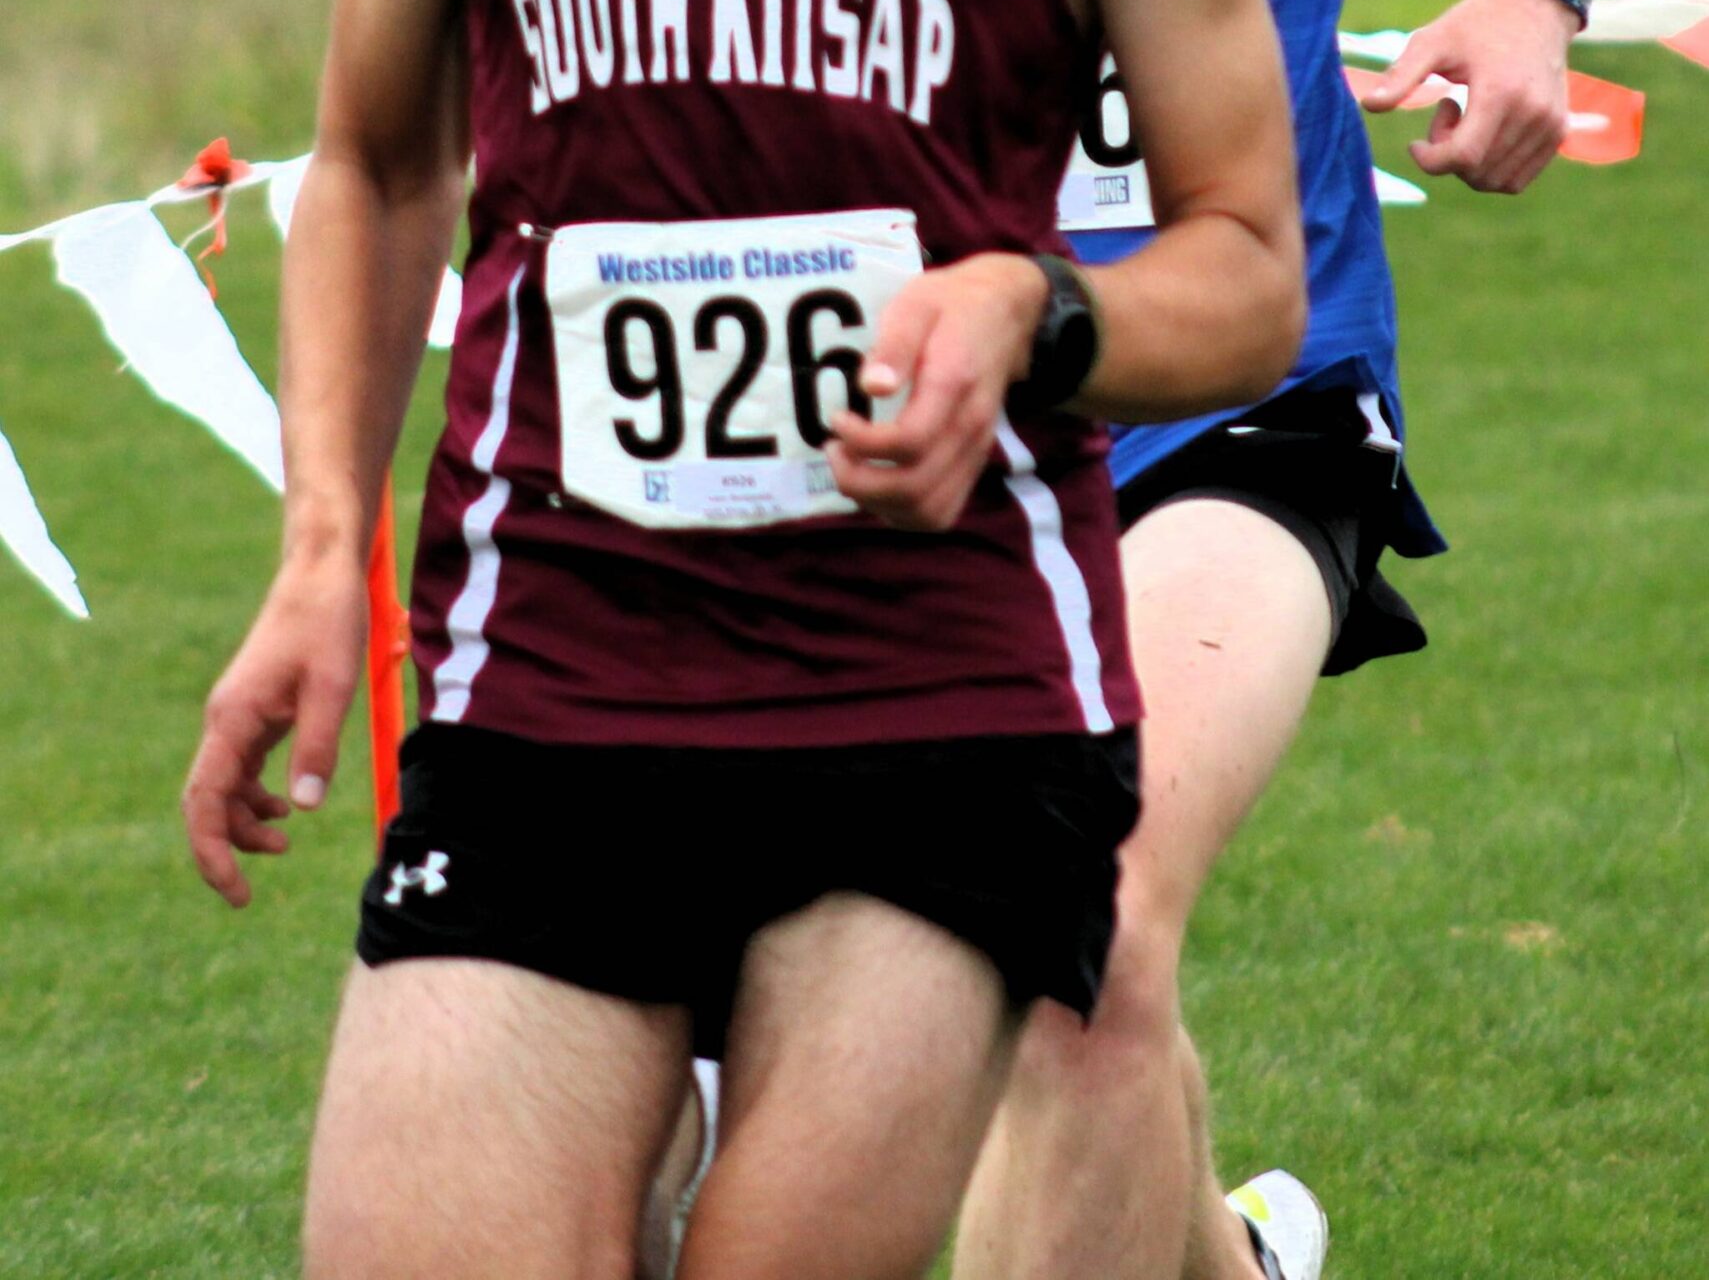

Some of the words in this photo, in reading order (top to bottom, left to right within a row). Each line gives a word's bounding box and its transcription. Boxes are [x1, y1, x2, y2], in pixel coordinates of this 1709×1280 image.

[598, 250, 735, 283] Westside
[742, 245, 857, 279] Classic
[603, 288, 874, 461] 926
